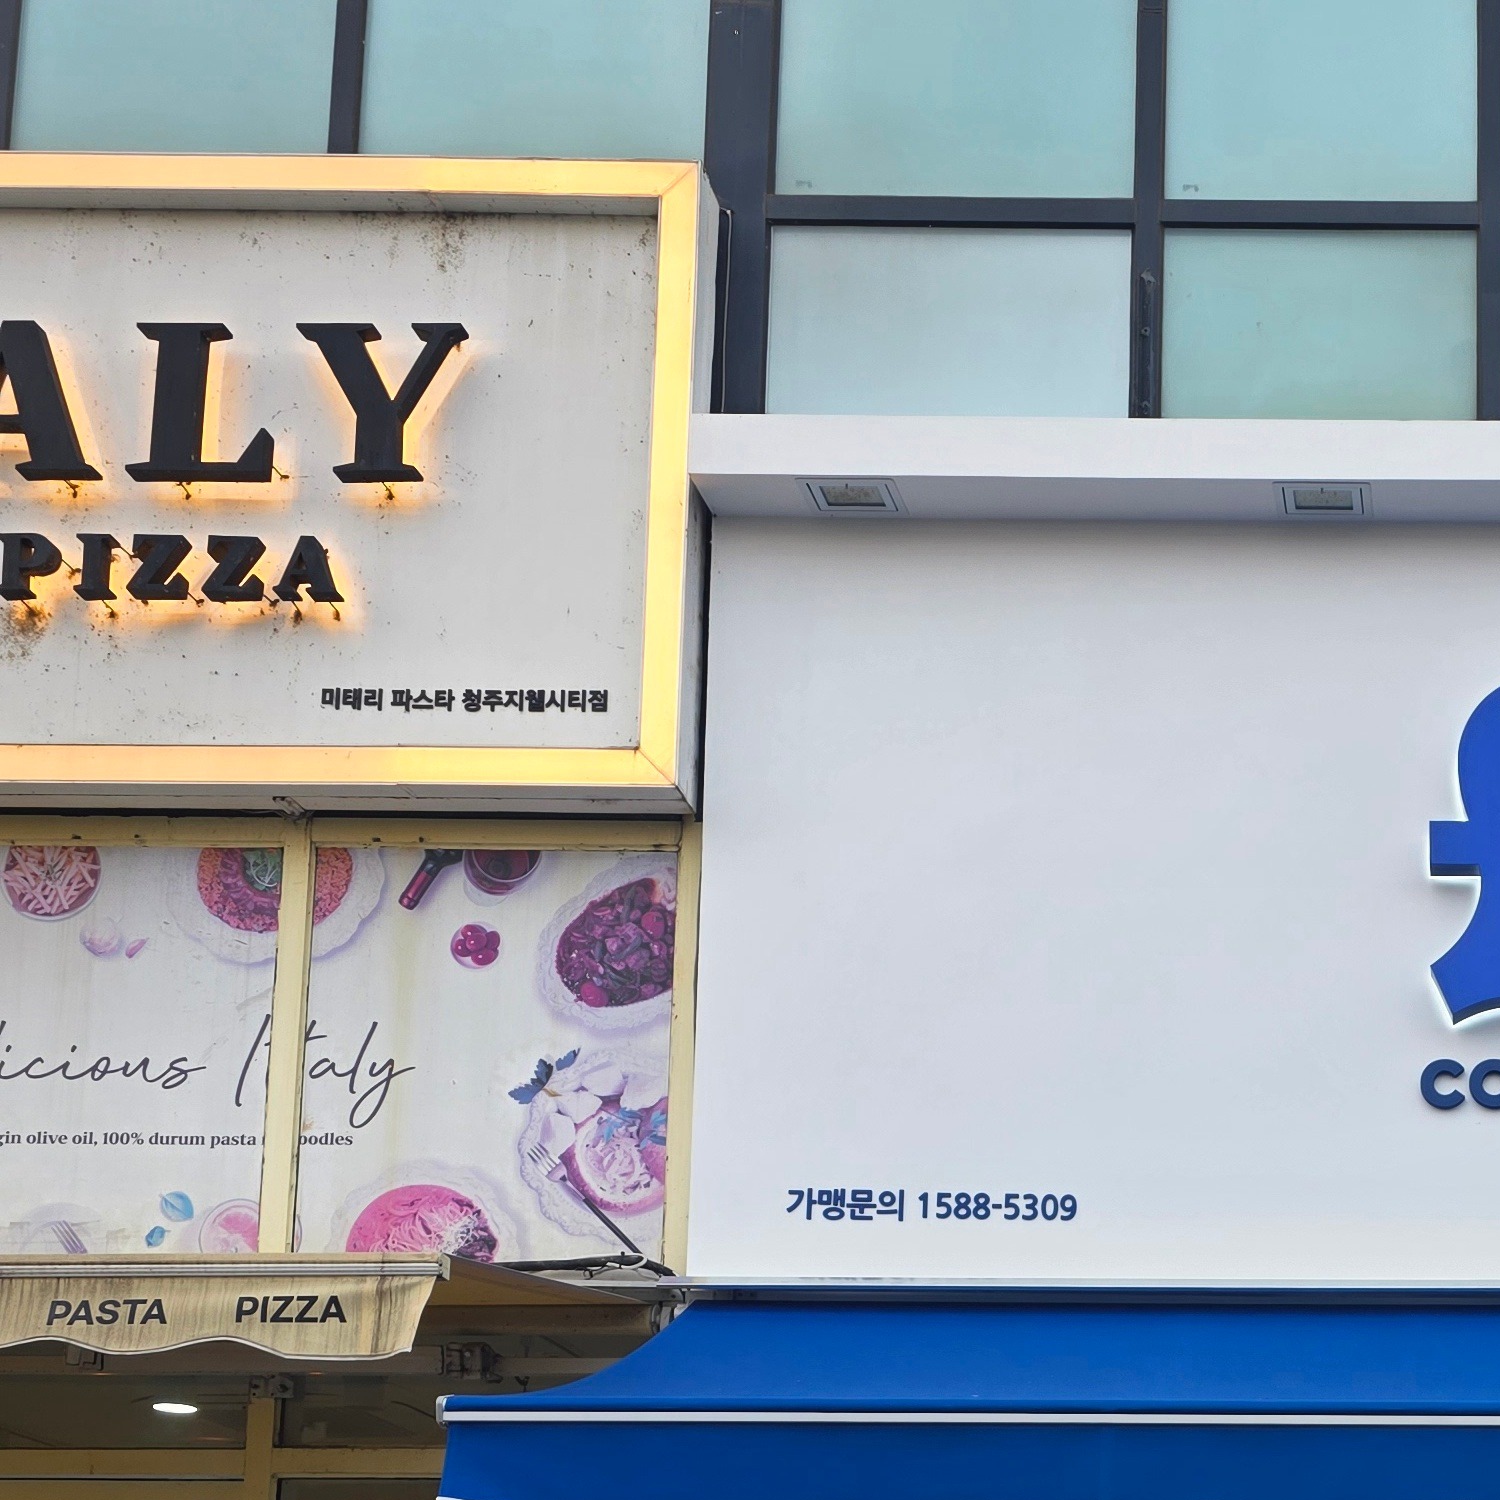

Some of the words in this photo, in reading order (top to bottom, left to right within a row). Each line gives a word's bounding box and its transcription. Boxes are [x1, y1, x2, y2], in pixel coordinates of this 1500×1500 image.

[0, 533, 344, 602] PIZZA
[321, 687, 384, 710] 미태리
[390, 688, 455, 712] 파스타
[461, 688, 608, 712] 청주지웰시티점
[26, 1131, 68, 1145] olive
[72, 1131, 98, 1147] oil,
[102, 1131, 144, 1146] 100%
[148, 1131, 205, 1146] durum
[210, 1134, 256, 1149] pasta
[786, 1188, 904, 1222] 가맹문의
[918, 1192, 1078, 1221] 1588-5309
[46, 1299, 167, 1326] PASTA
[235, 1295, 347, 1324] PIZZA
